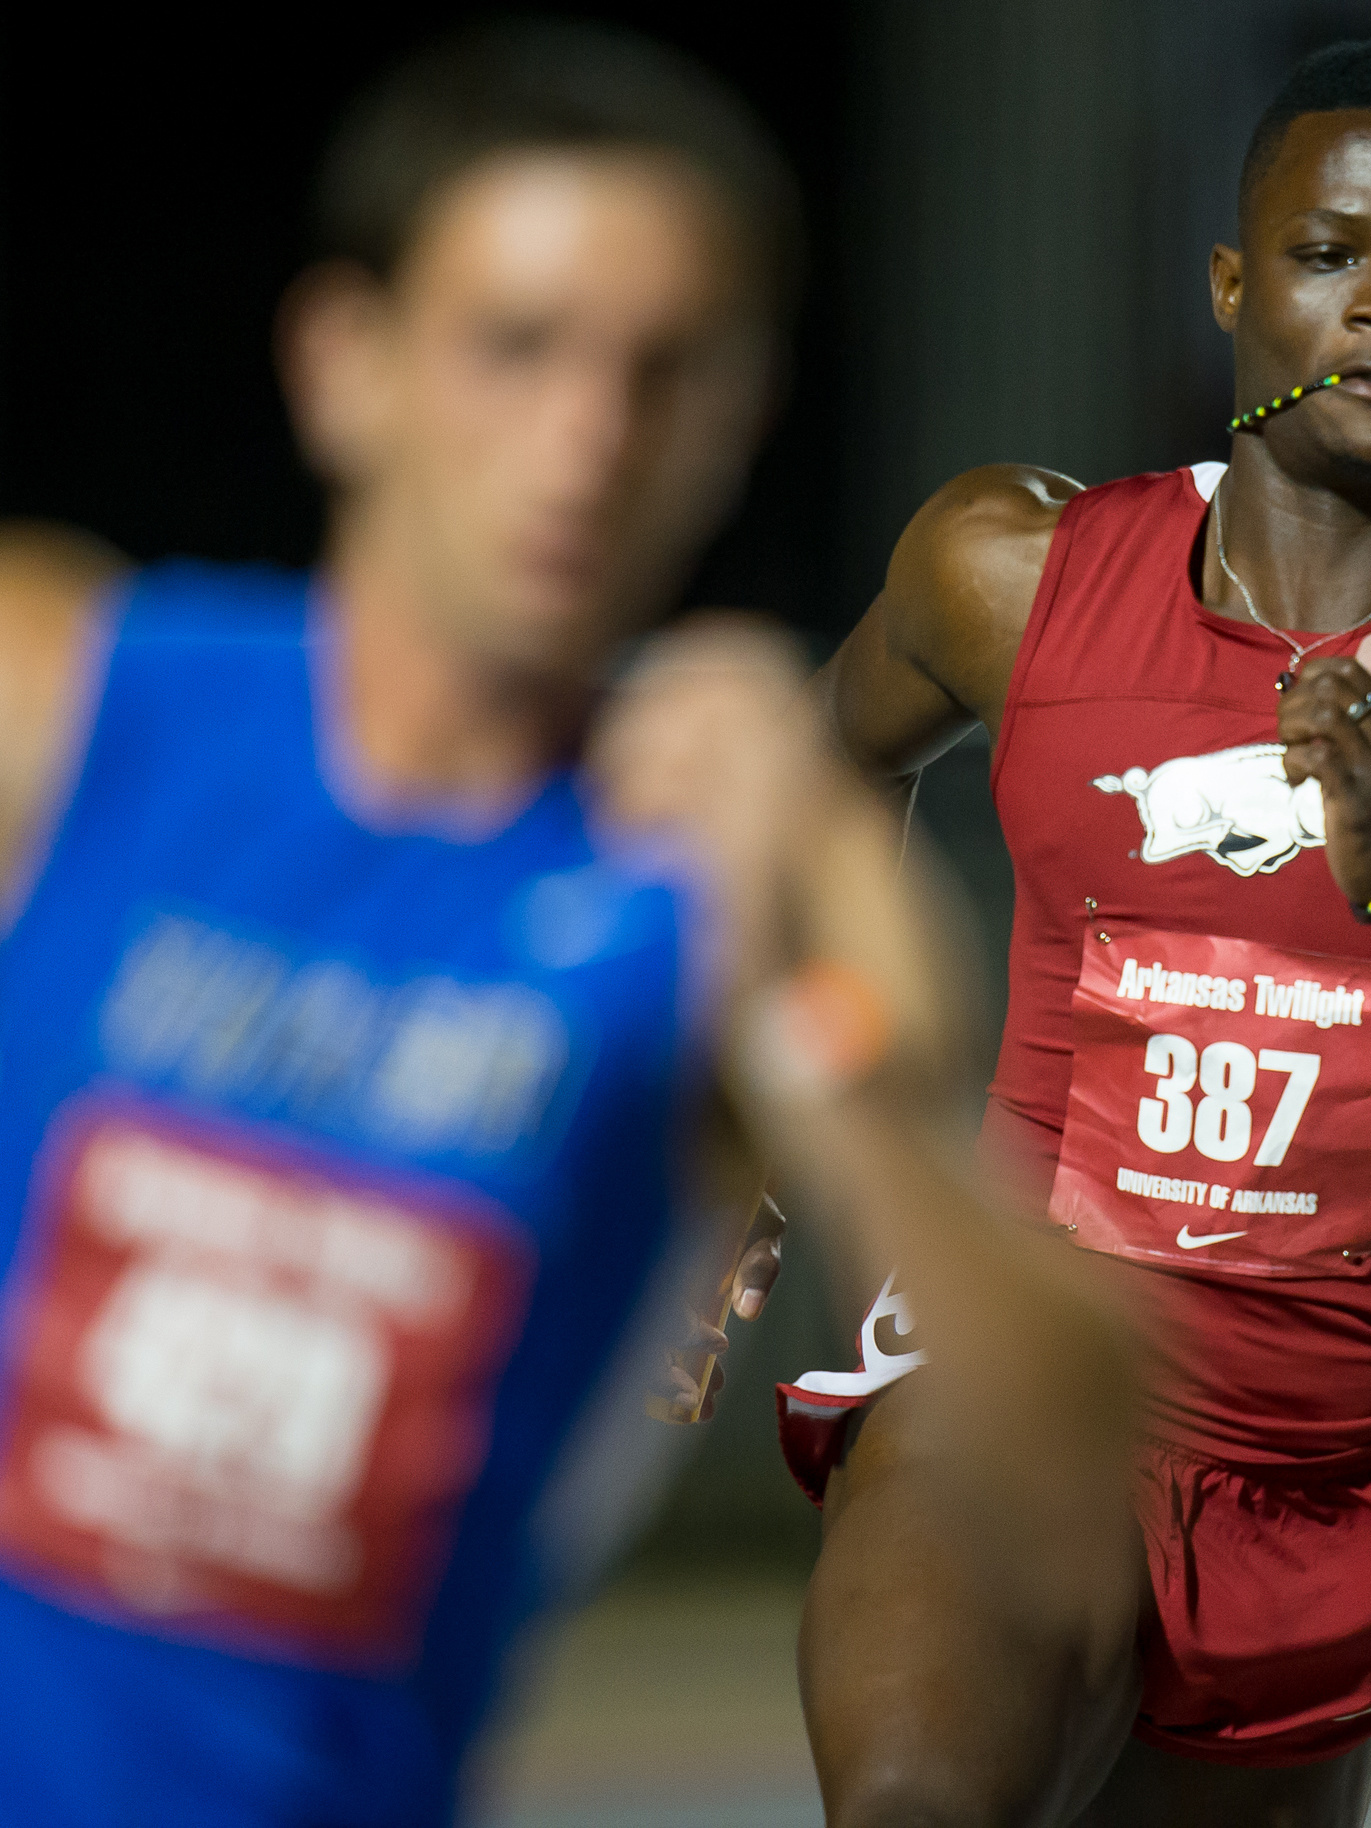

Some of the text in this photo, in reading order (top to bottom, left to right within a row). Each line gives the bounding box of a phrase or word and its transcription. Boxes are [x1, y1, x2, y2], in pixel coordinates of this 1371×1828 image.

[1116, 958, 1365, 1029] Arkansas Twilight
[1136, 1033, 1322, 1167] 387
[1116, 1166, 1319, 1215] UNIVERSITY OF ARKANSAS
